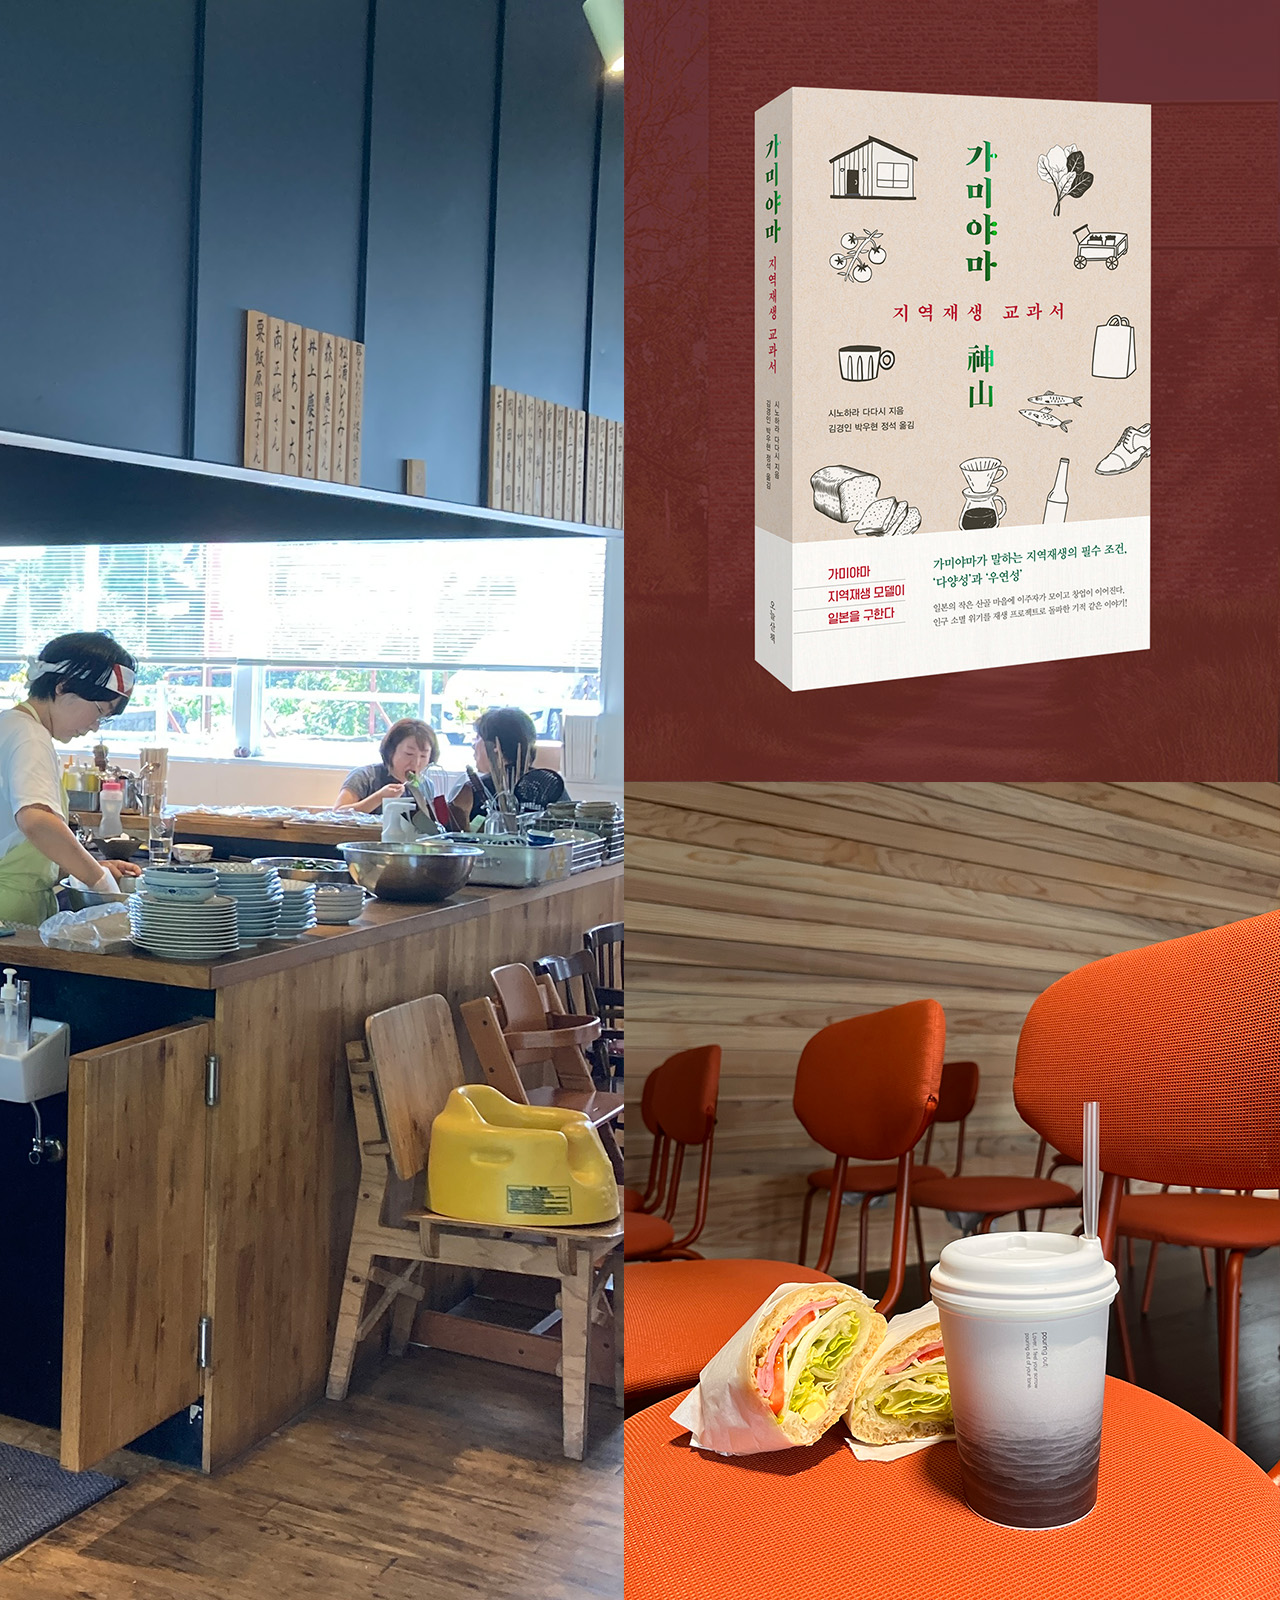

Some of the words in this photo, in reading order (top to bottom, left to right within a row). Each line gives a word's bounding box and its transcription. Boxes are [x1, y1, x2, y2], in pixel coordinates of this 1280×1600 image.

[766, 134, 781, 243] 가미야마
[966, 141, 997, 281] 가미야마
[893, 303, 981, 322] 지역재생
[1003, 302, 1063, 320] 교과서
[769, 329, 777, 374] 교과서
[968, 345, 994, 408] 神山
[828, 408, 860, 418] 시노하라
[862, 407, 886, 416] 다다시
[889, 406, 904, 415] 지음
[829, 424, 852, 433] 김경인
[855, 422, 878, 431] 박우현
[881, 422, 896, 430] 정석
[899, 421, 915, 430] 옮김
[766, 454, 771, 470] 정석
[774, 463, 780, 479] 지음
[766, 473, 771, 490] 옮김
[934, 554, 987, 570] 가미야마가
[991, 552, 1023, 565] 말하는
[1027, 547, 1076, 562] 지역재생의
[1082, 545, 1101, 557] 필수
[829, 566, 870, 580] 가미야마
[828, 588, 870, 602] 지역재생
[874, 584, 904, 598] 모델이
[933, 602, 956, 613] 일본의
[958, 601, 974, 609] 작은
[975, 599, 990, 609] 산골
[993, 596, 1015, 607] 마을에
[1017, 593, 1047, 604] 이주자가
[1048, 591, 1070, 601] 모이고
[1072, 589, 1093, 599] 창업이
[828, 611, 860, 624] 일본을
[864, 607, 895, 621] 구한다
